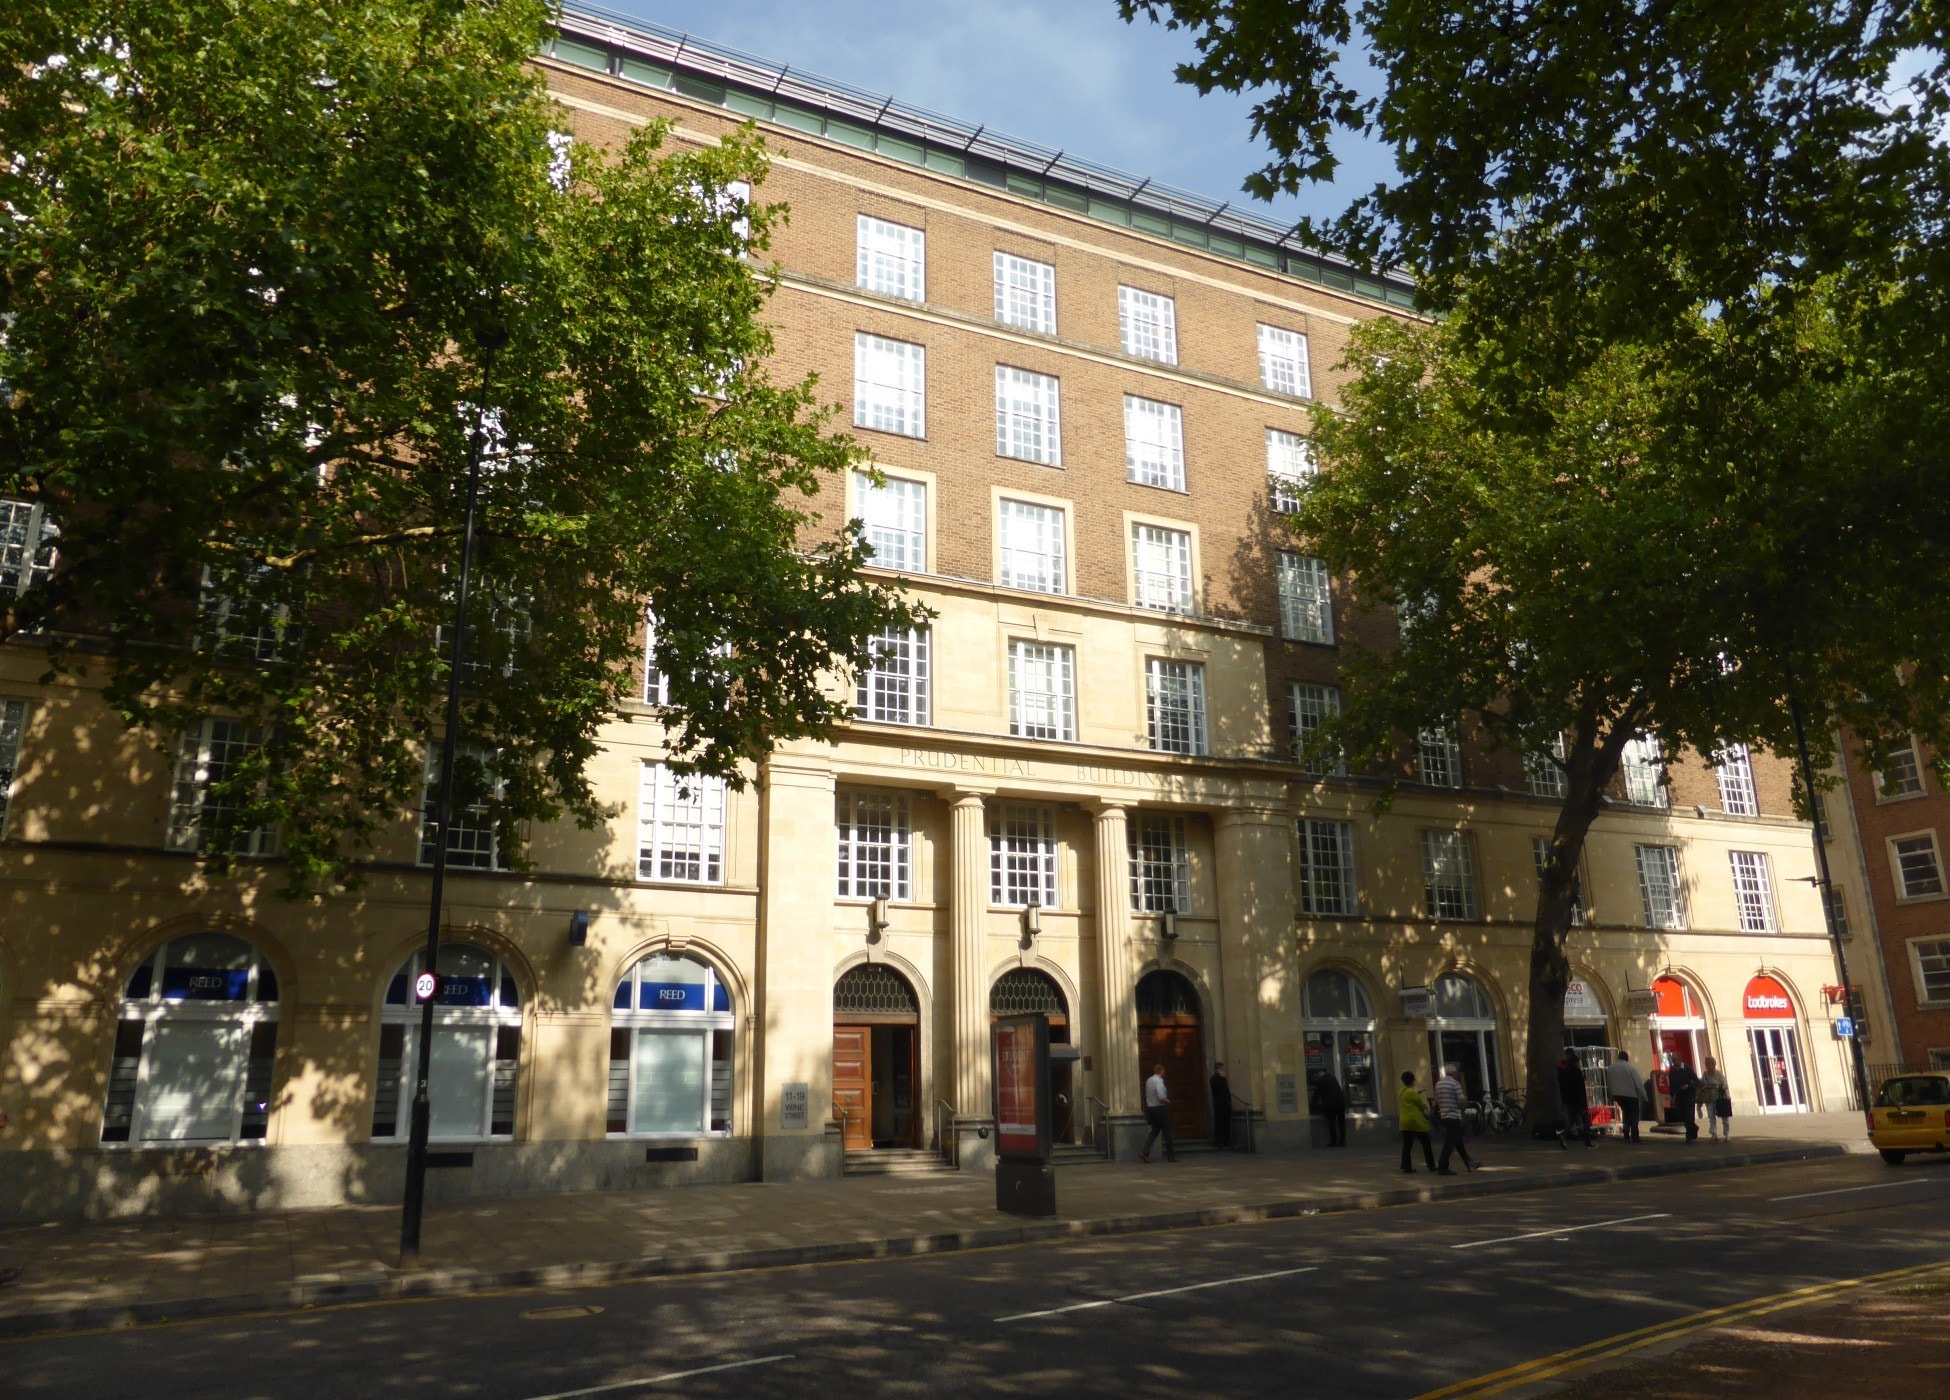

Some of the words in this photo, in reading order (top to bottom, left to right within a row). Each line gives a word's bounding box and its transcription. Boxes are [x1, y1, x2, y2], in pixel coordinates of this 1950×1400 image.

[900, 747, 1036, 776] PRUDENTIAL
[189, 976, 222, 988] REED
[418, 980, 432, 991] 20
[659, 989, 686, 1000] REED
[1747, 996, 1788, 1009] Ladbrokes
[784, 1091, 805, 1101] 11-19
[784, 1103, 804, 1111] WINE
